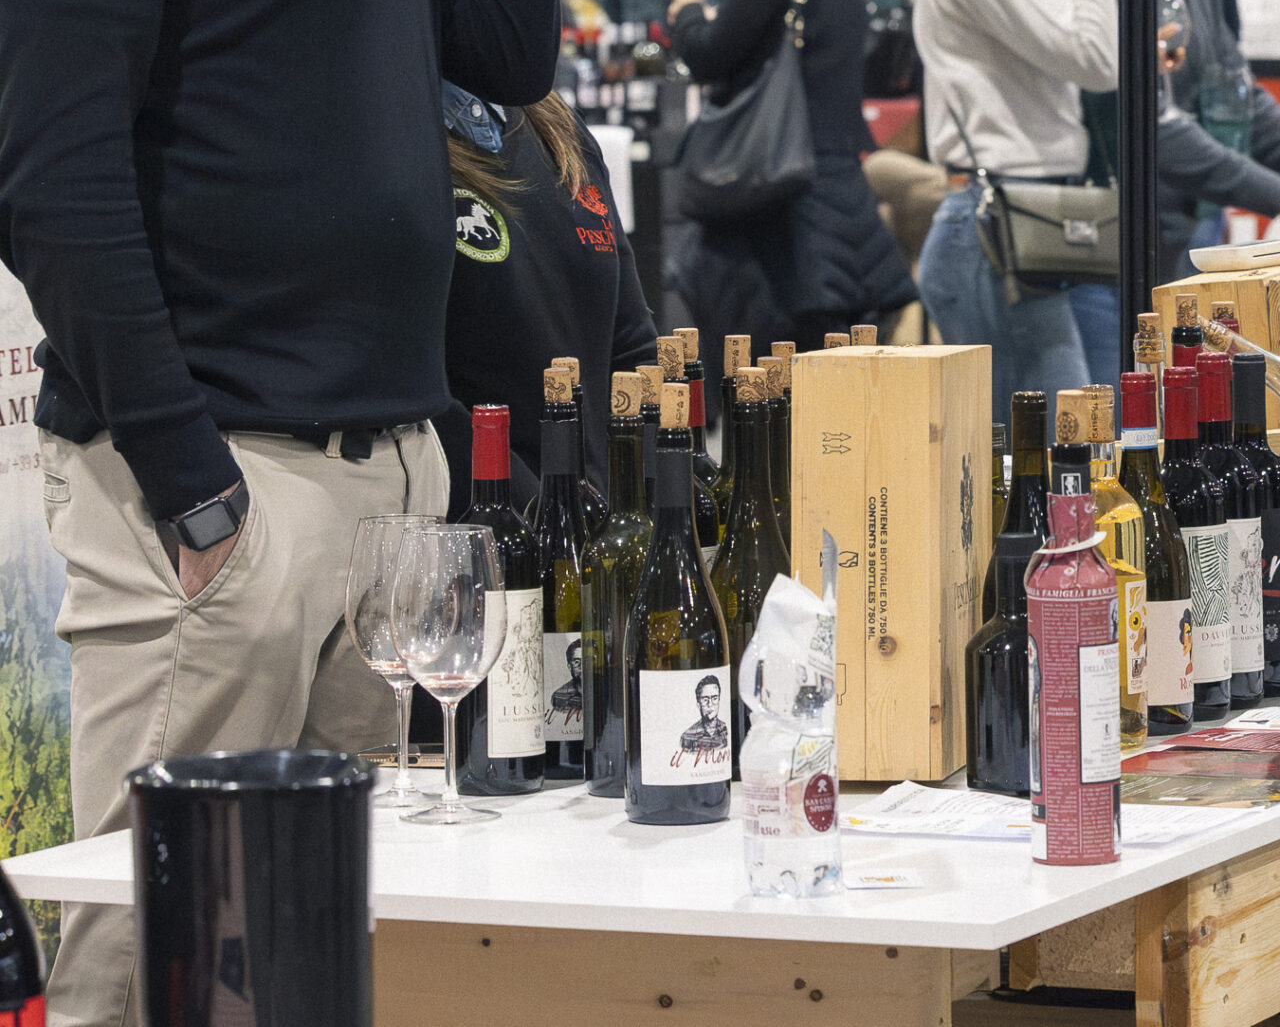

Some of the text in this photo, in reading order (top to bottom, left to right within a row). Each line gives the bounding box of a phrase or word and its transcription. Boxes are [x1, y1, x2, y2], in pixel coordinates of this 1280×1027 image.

[880, 486, 888, 537] CONTIENE
[868, 496, 876, 550] CONTENTS
[868, 560, 876, 604] BOTTLES
[880, 547, 888, 599] BOTTIGLIE
[1042, 589, 1084, 598] FAMIGLIA
[868, 606, 876, 624] 750
[880, 600, 887, 614] DA
[879, 616, 887, 634] 750
[670, 746, 687, 768] il
